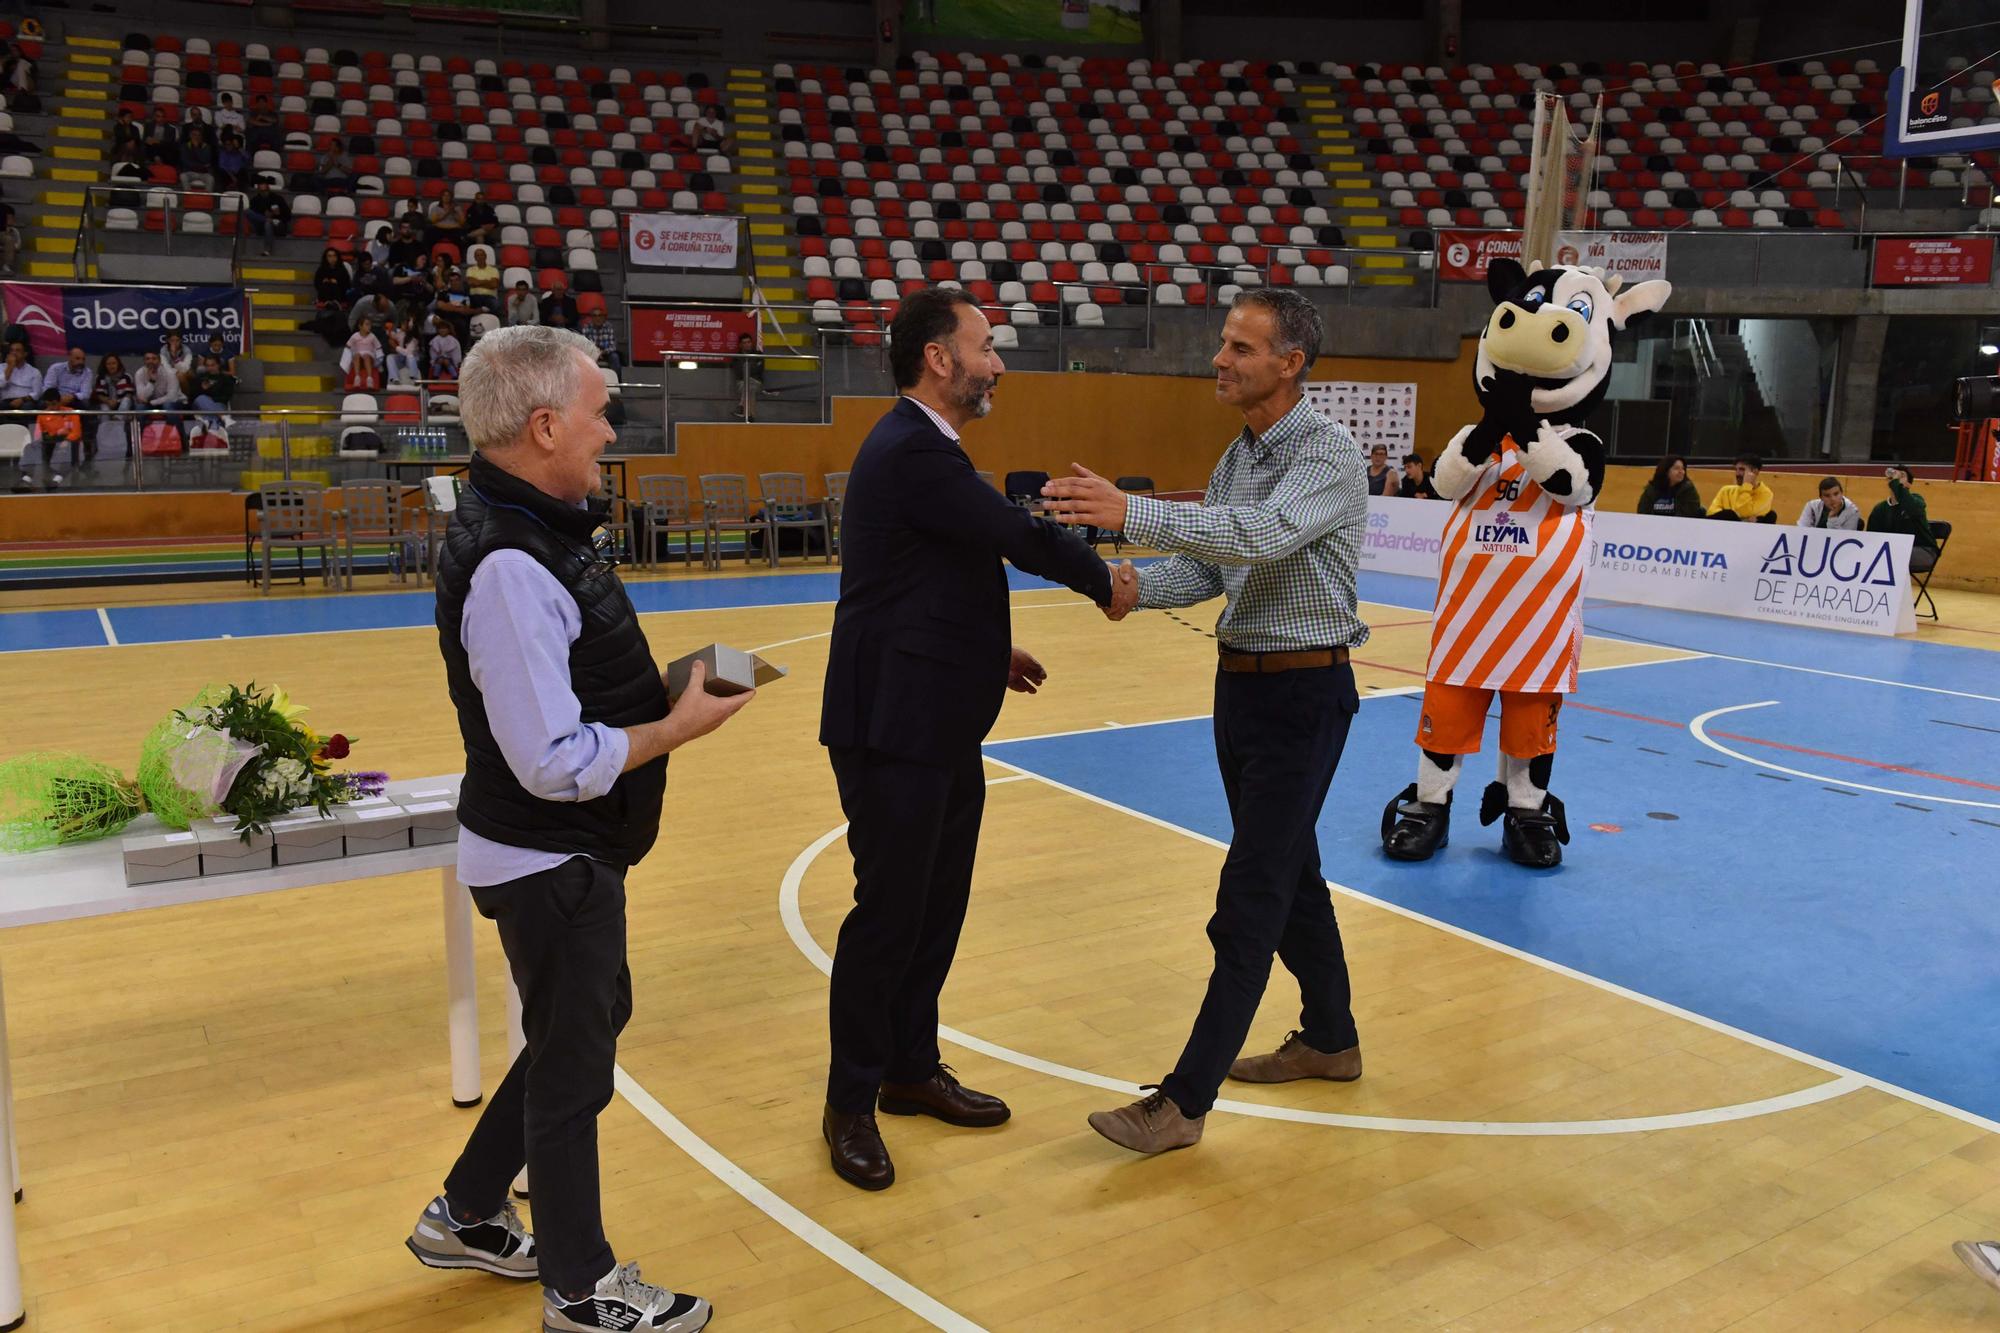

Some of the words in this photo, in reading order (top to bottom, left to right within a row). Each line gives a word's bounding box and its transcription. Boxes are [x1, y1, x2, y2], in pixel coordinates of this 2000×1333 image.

[660, 231, 671, 240] SE
[672, 231, 690, 241] CHE
[1606, 258, 1614, 271] A
[1616, 256, 1661, 271] CORUÑA
[72, 300, 241, 330] abeconsa
[1494, 478, 1521, 502] 96
[1360, 529, 1442, 554] mbardero
[1475, 525, 1530, 545] LEYMA
[1481, 543, 1518, 553] NATURA
[1602, 542, 1728, 570] RODONITA
[1760, 533, 1896, 586] AUGA
[1600, 561, 1728, 582] MEDIOAMBIENTE
[1754, 578, 1787, 604] DE
[1792, 582, 1890, 617] PARADA
